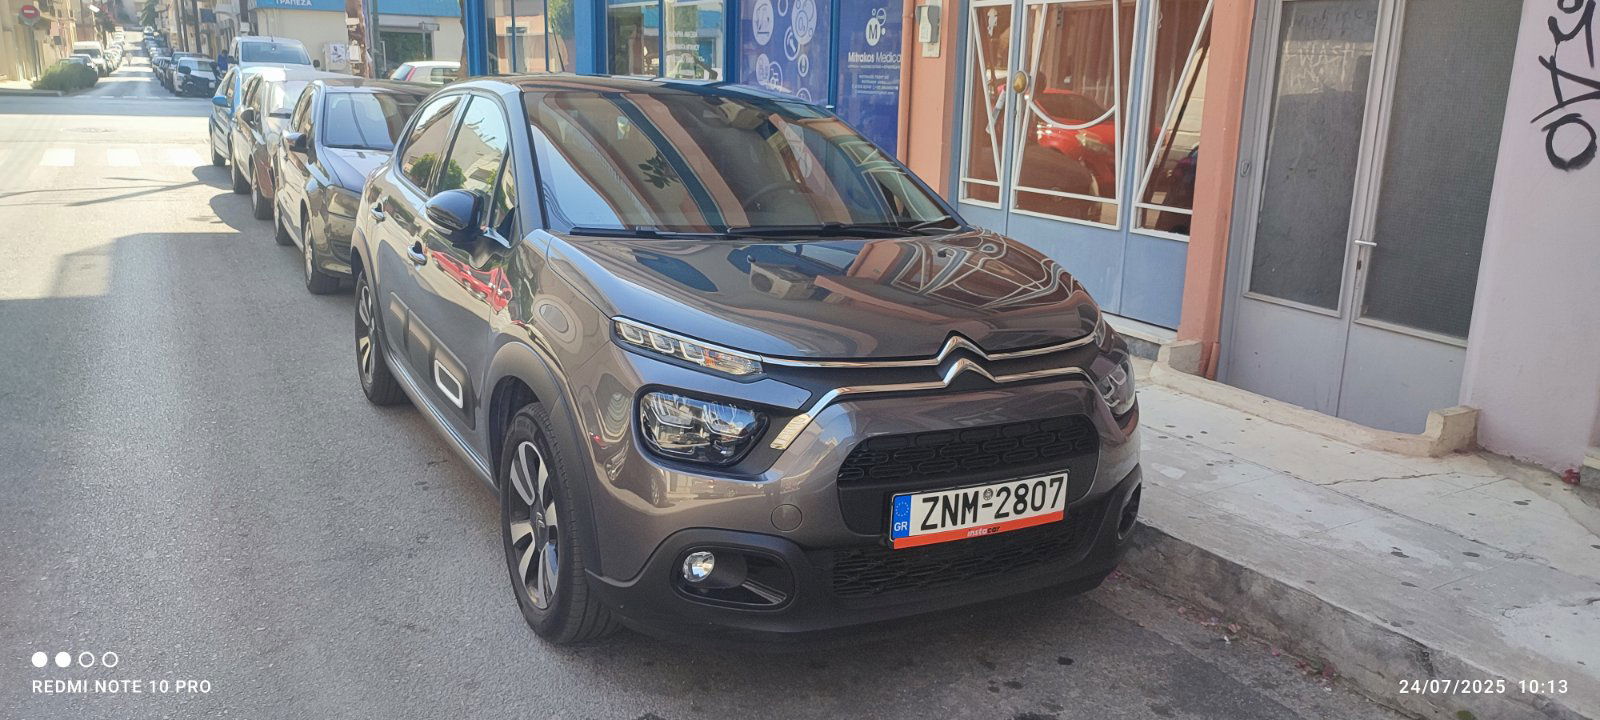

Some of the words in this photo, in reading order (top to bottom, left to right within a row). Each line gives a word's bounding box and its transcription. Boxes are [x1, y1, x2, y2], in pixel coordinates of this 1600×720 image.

[868, 24, 878, 39] M
[847, 51, 875, 63] Mitrakos
[875, 51, 902, 63] Medica
[920, 476, 1064, 531] ZNM-2807
[893, 521, 908, 532] GR
[967, 525, 1001, 537] instacar
